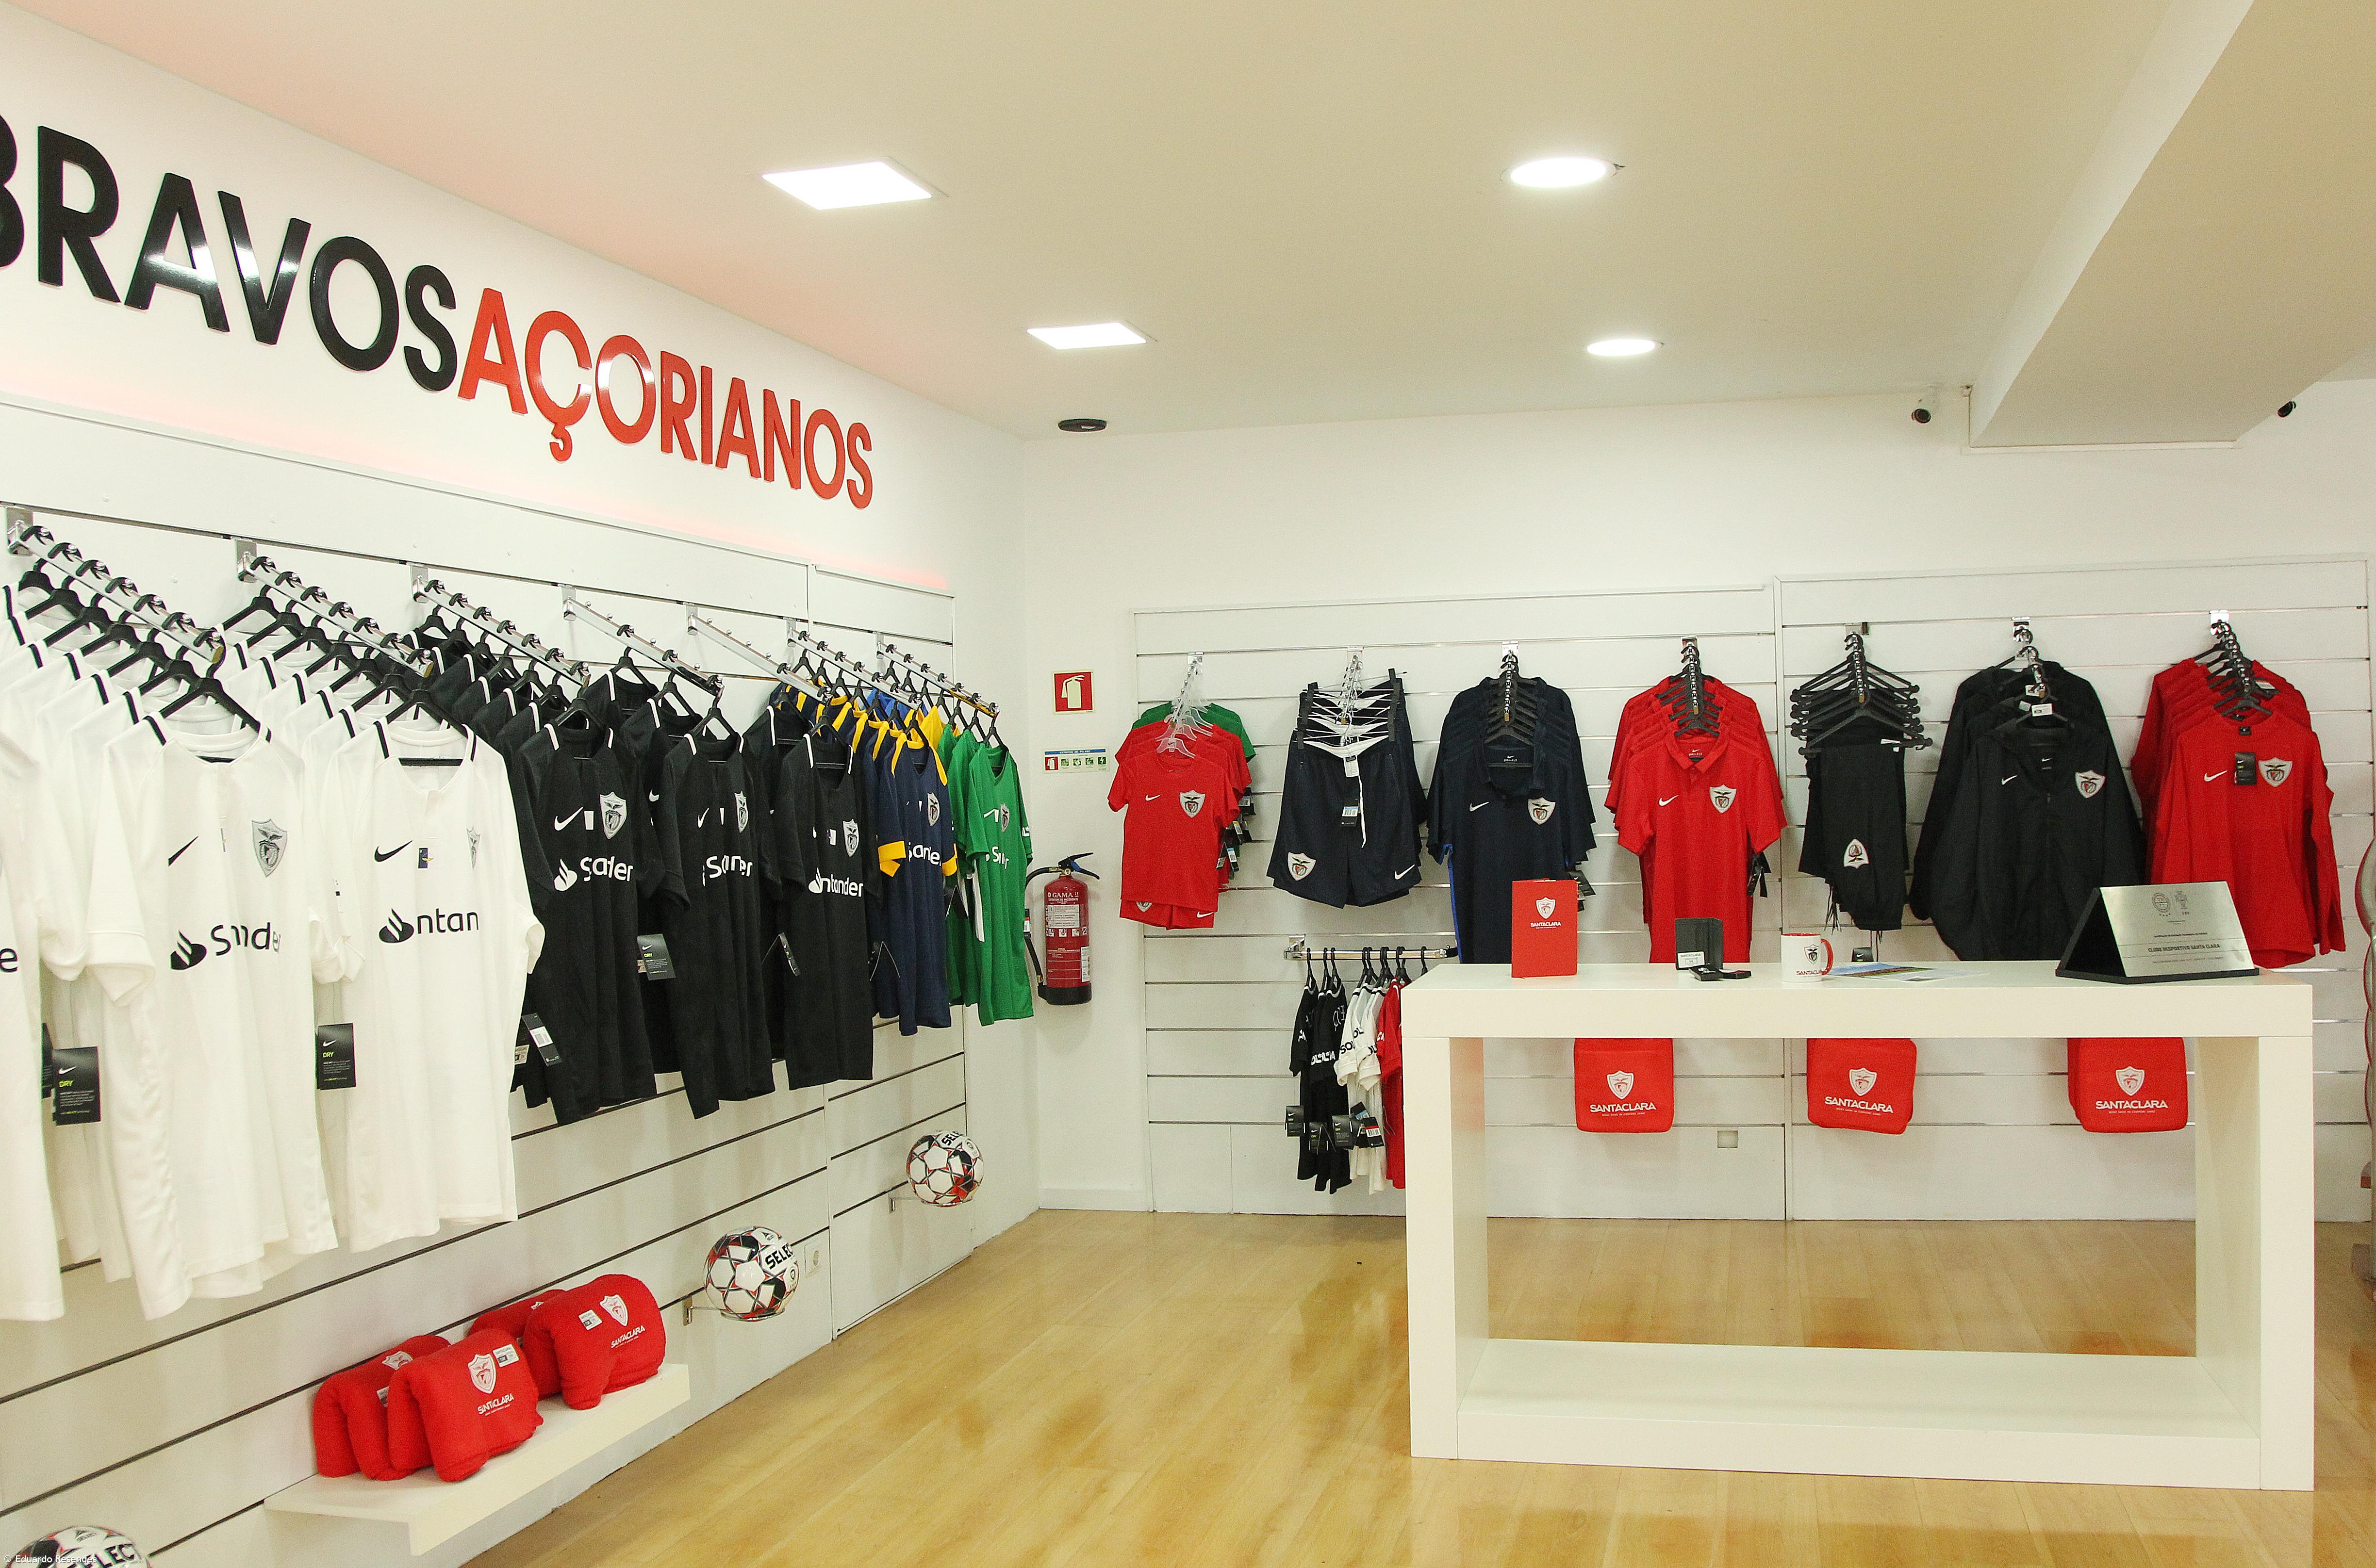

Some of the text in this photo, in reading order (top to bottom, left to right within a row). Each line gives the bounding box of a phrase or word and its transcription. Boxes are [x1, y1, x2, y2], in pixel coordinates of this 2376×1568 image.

[1590, 1102, 1657, 1113] SANTACLARA
[1824, 1096, 1894, 1114] SANTACLARA
[2096, 1100, 2169, 1110] SANTACLARA
